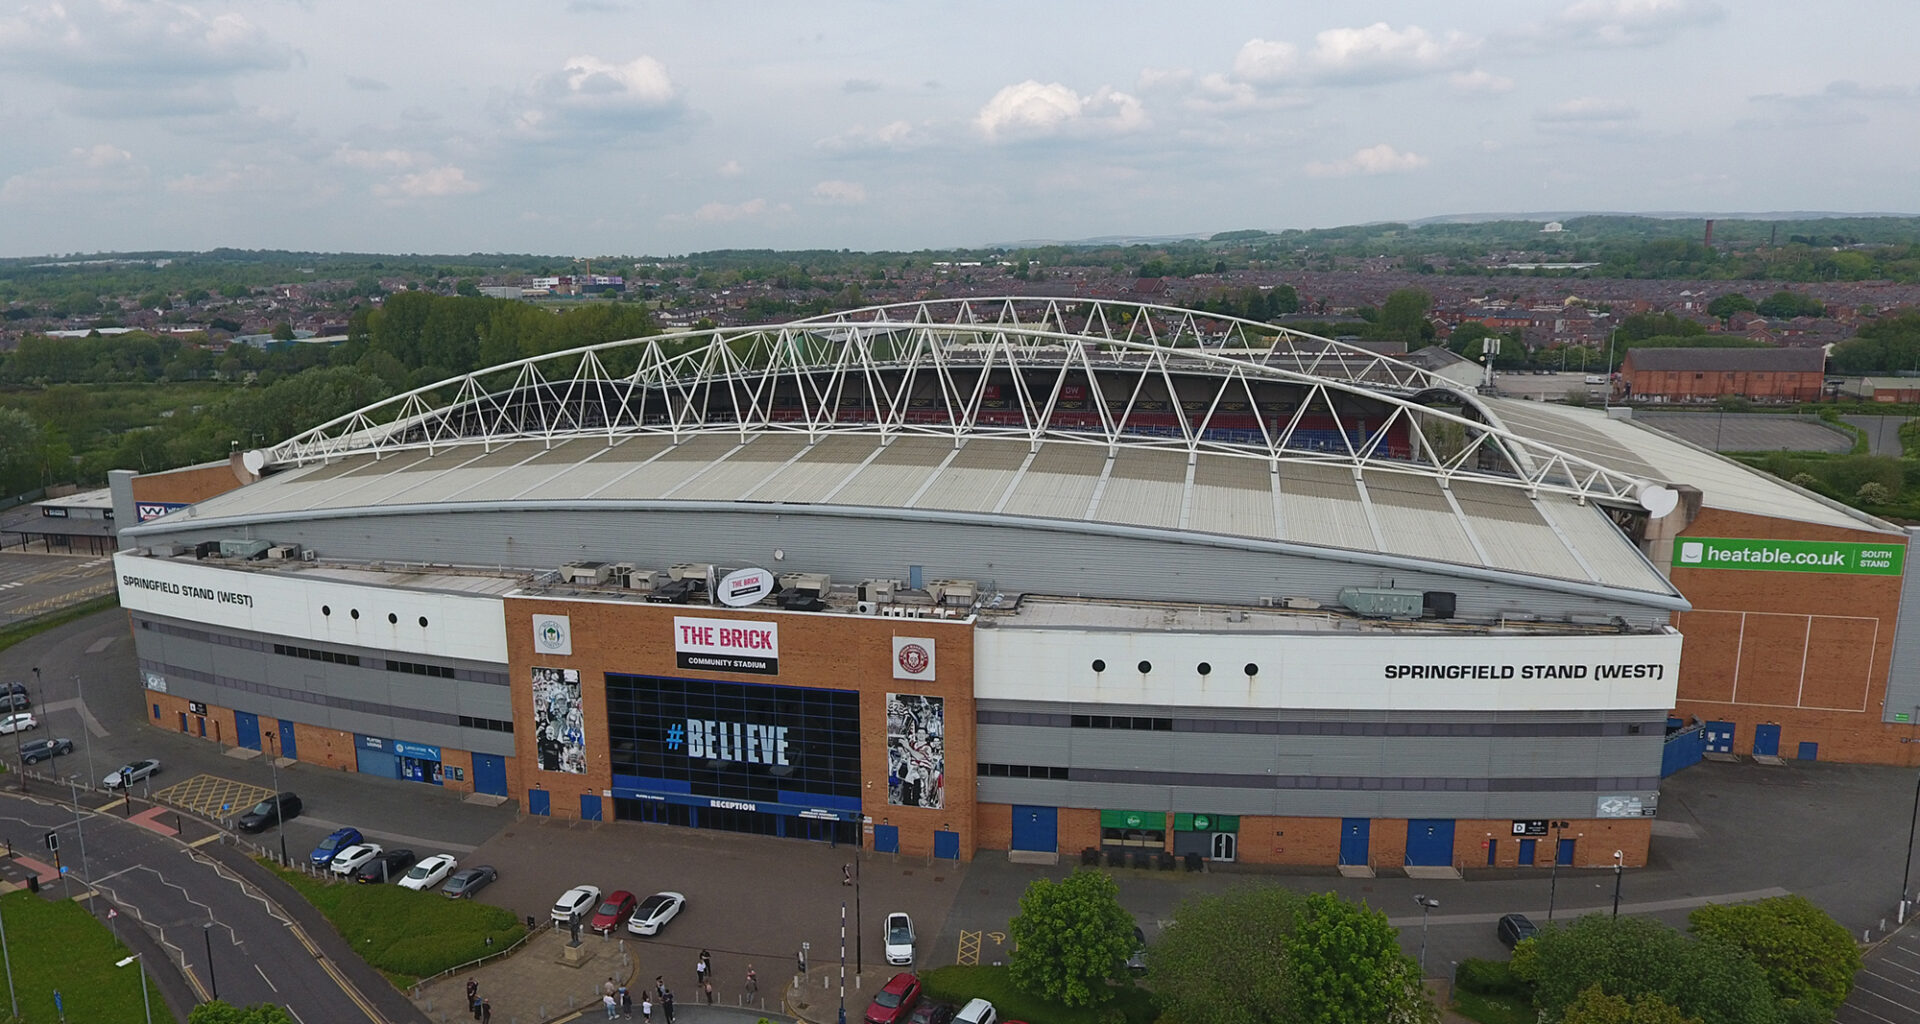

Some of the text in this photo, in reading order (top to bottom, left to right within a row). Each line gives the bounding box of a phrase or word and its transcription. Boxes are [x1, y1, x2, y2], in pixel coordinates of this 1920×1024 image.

[1707, 546, 1846, 566] heatable.co.uk
[1861, 550, 1892, 559] SOUTH
[1860, 559, 1890, 568] STAND
[123, 575, 253, 608] SPRINGFIELD STAND (WEST)
[680, 625, 773, 650] THE BRICK
[688, 657, 766, 669] COMMUNITY STADIUM
[1384, 664, 1664, 681] SPRINGFIELD STAND (WEST)
[665, 718, 790, 766] #BELIEVE
[710, 800, 755, 811] RECEPTION
